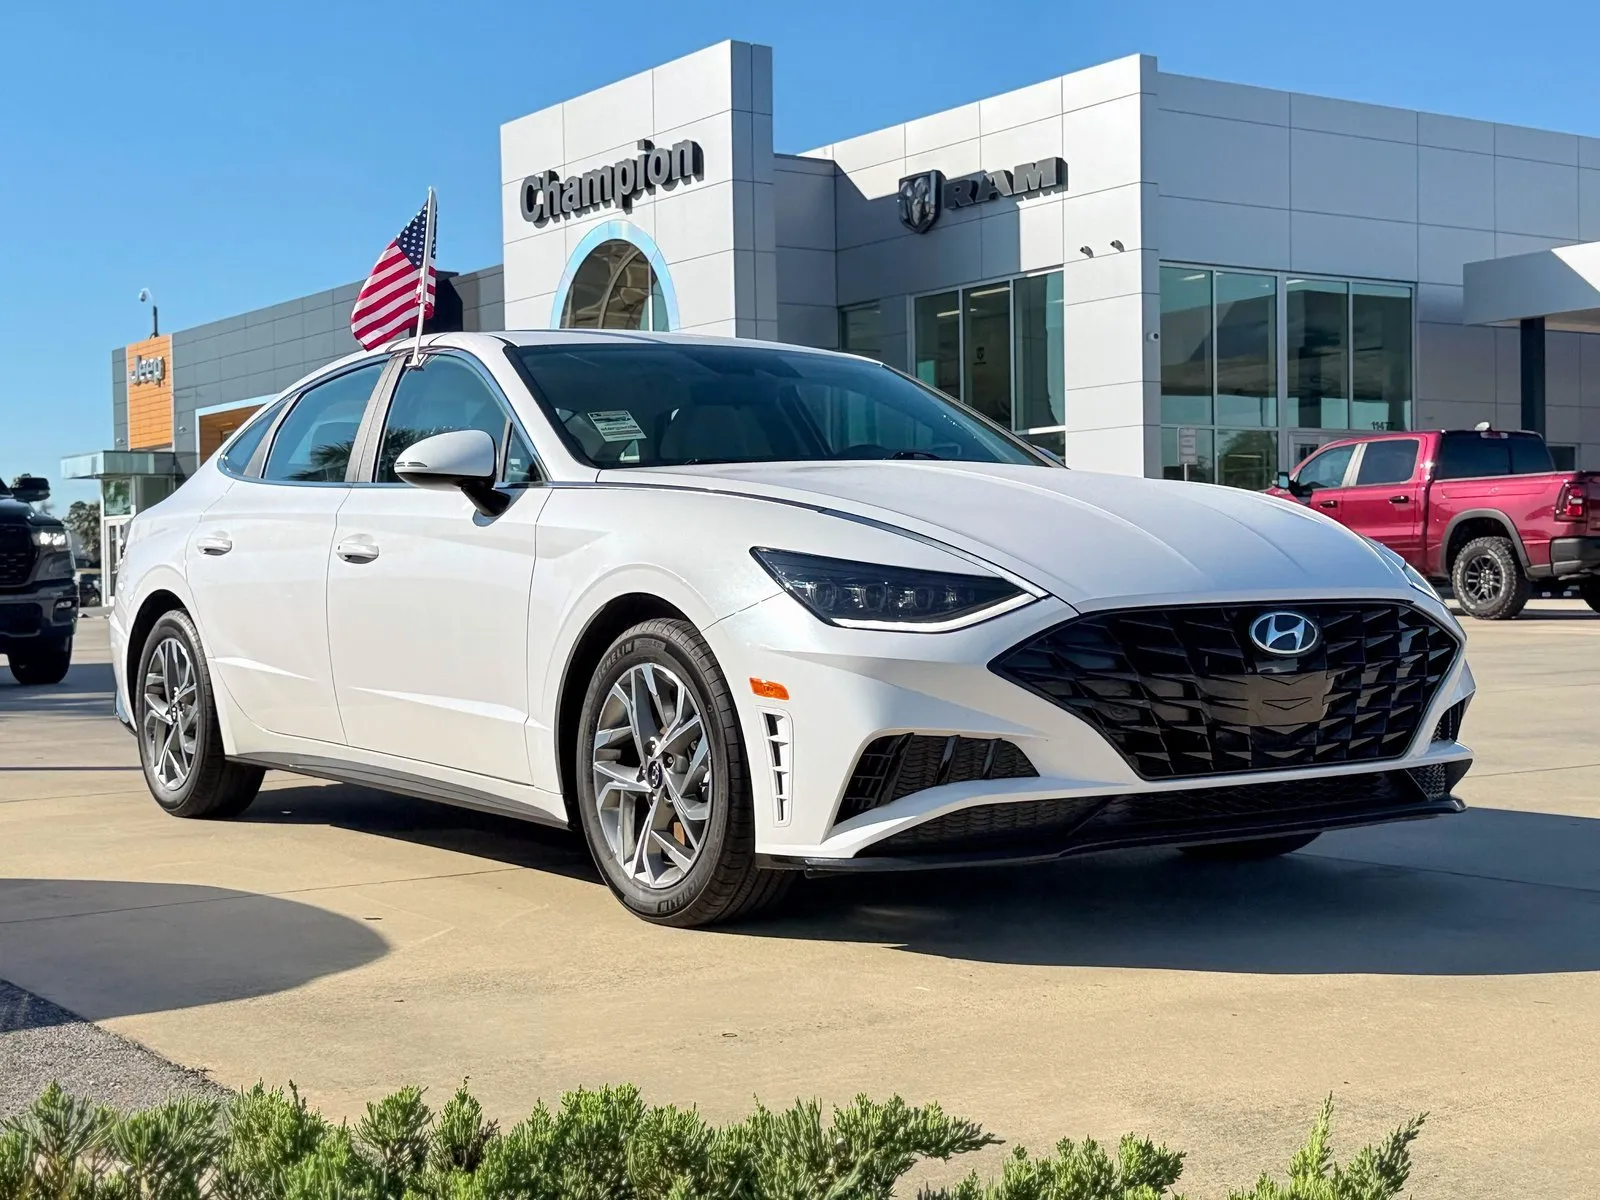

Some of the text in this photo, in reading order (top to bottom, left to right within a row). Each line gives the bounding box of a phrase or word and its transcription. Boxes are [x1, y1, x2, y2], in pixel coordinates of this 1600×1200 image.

[520, 139, 703, 227] Champion
[944, 157, 1067, 209] RAM
[131, 355, 165, 386] Jeep
